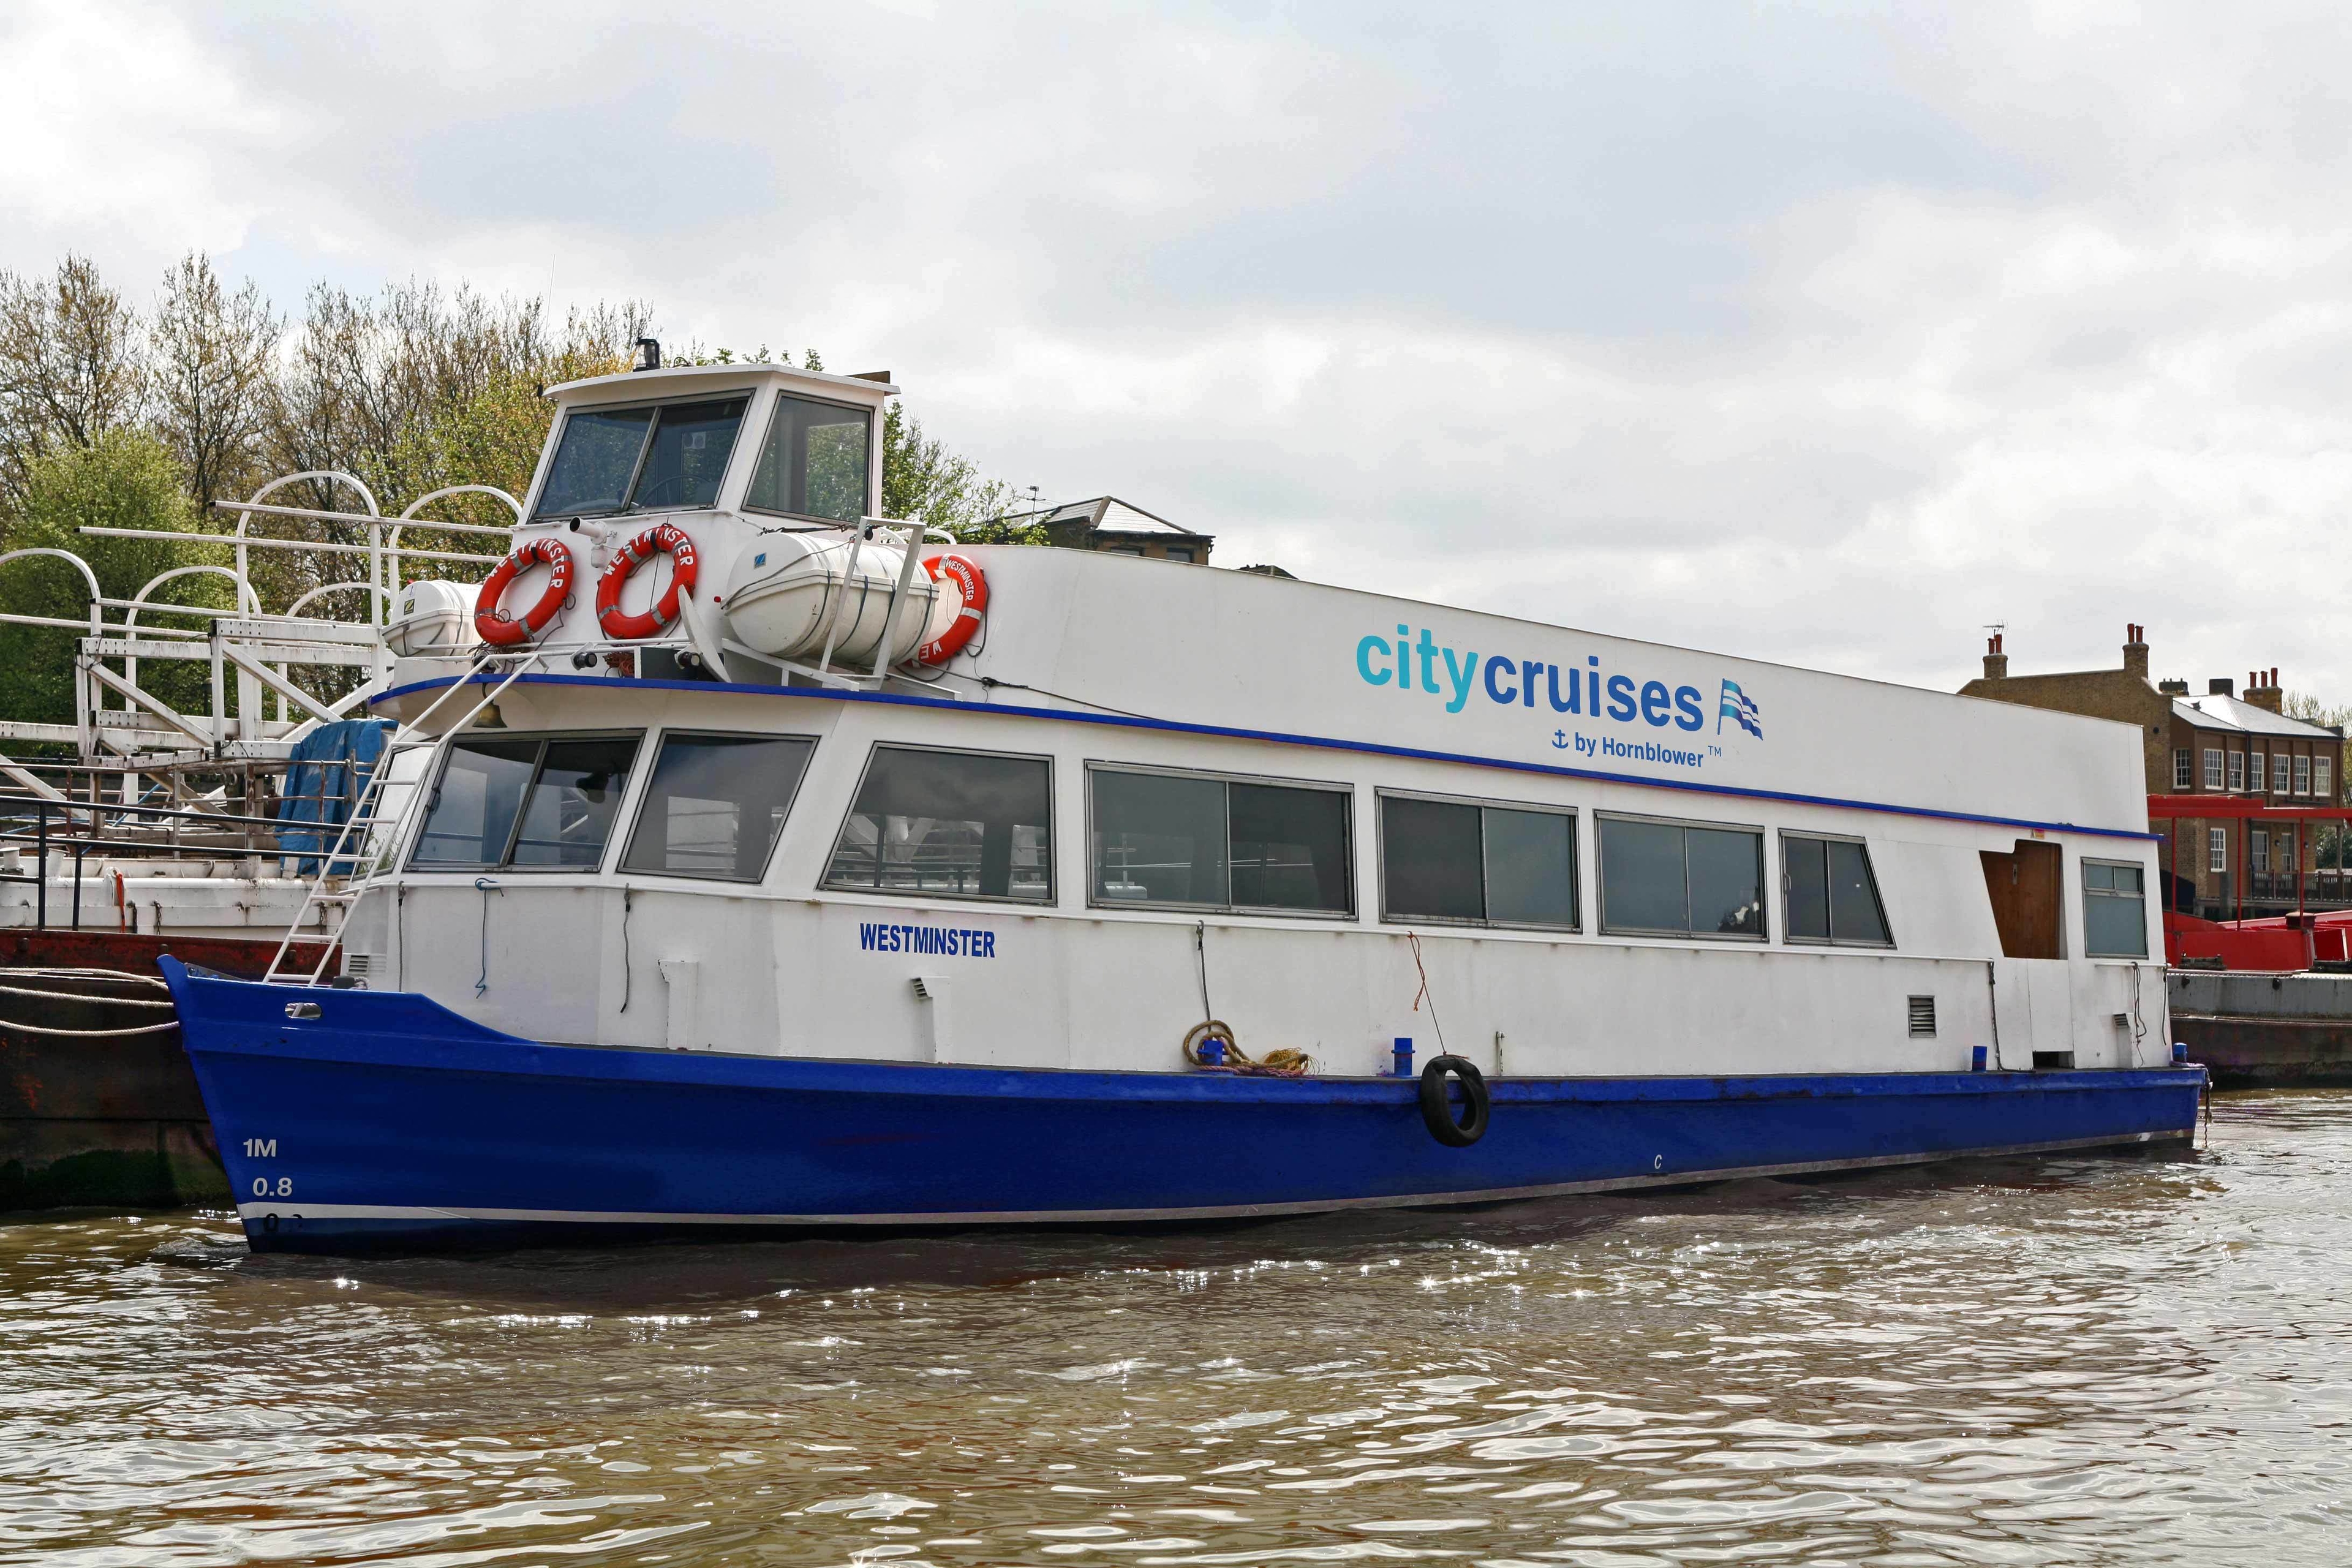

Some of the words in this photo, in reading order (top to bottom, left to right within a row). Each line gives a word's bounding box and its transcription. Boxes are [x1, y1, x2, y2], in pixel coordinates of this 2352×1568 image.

[946, 559, 975, 601] WESTMINSTER
[1575, 732, 1597, 757] by
[1602, 737, 1704, 767] Hornblower
[859, 922, 995, 958] WESTMINSTER
[243, 1139, 276, 1157] 1M
[253, 1177, 292, 1196] 0.8
